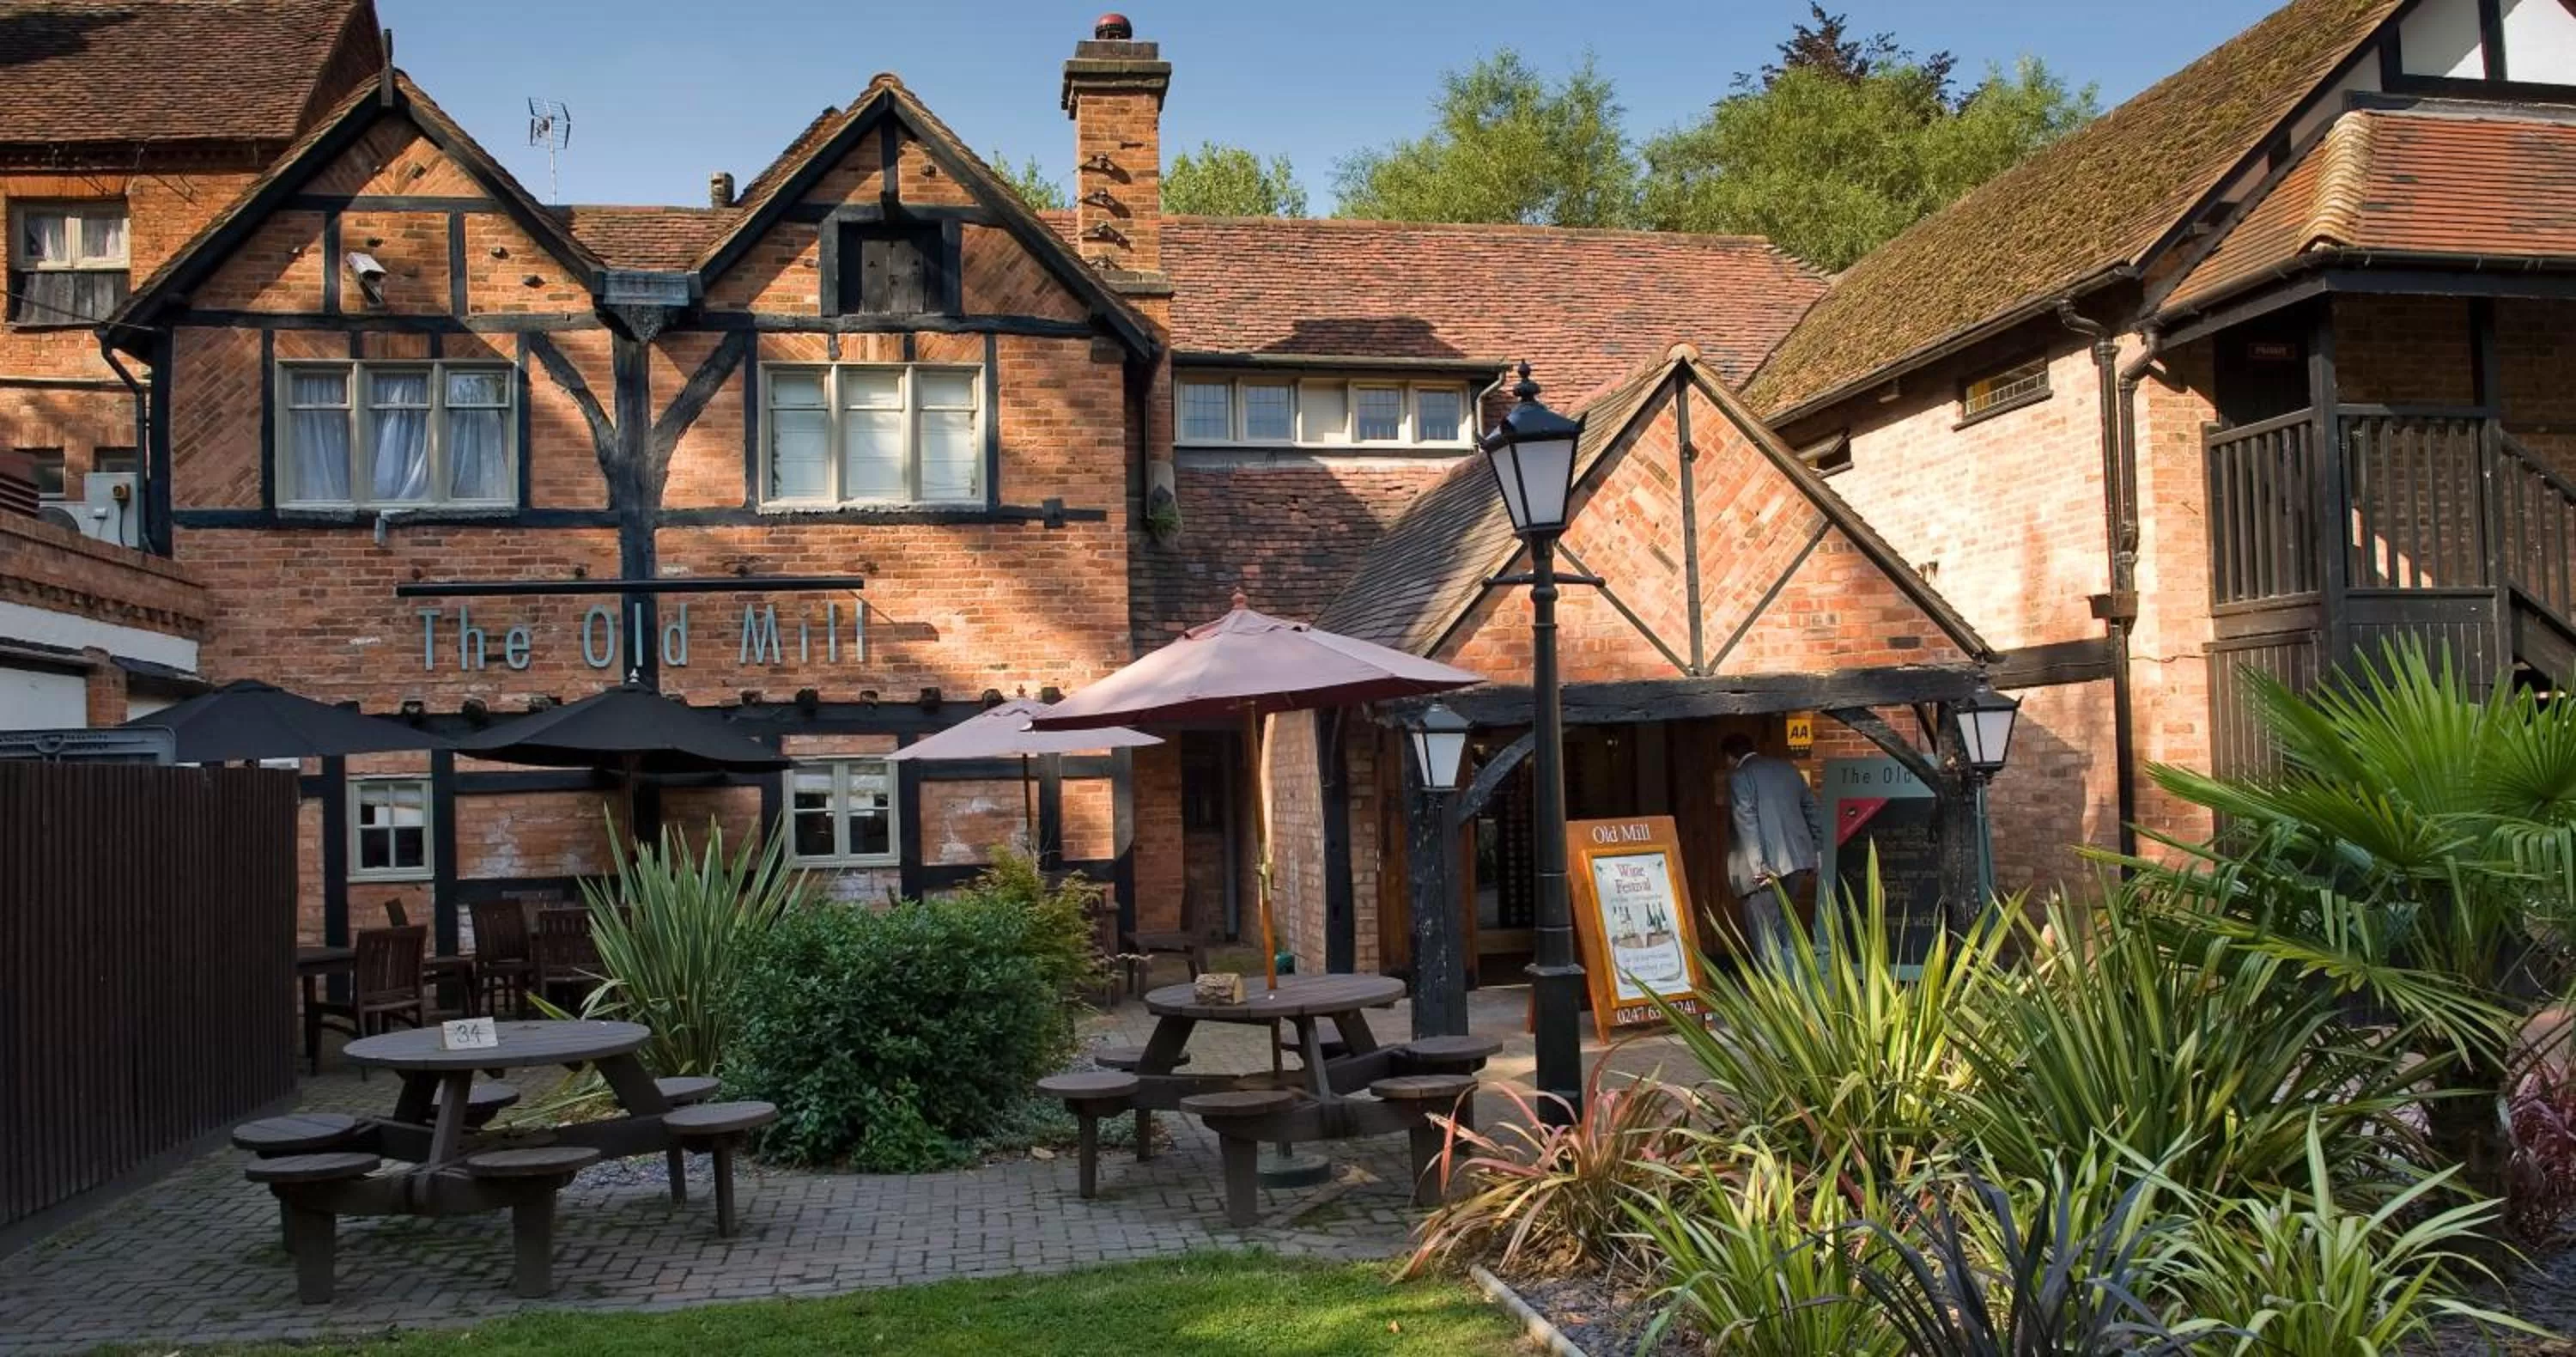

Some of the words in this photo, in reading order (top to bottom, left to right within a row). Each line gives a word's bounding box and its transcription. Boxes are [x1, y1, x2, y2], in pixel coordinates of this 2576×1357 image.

[418, 603, 532, 671] The
[582, 602, 688, 668] Old
[739, 601, 866, 665] Mill
[1789, 725, 1809, 739] AA
[1840, 766, 1871, 784] The
[1593, 825, 1619, 843] Old
[1620, 824, 1652, 842] Mill
[1615, 863, 1646, 877] Wine
[1614, 878, 1652, 894] Festival
[1617, 1006, 1644, 1025] 0247
[456, 1023, 485, 1044] 34
